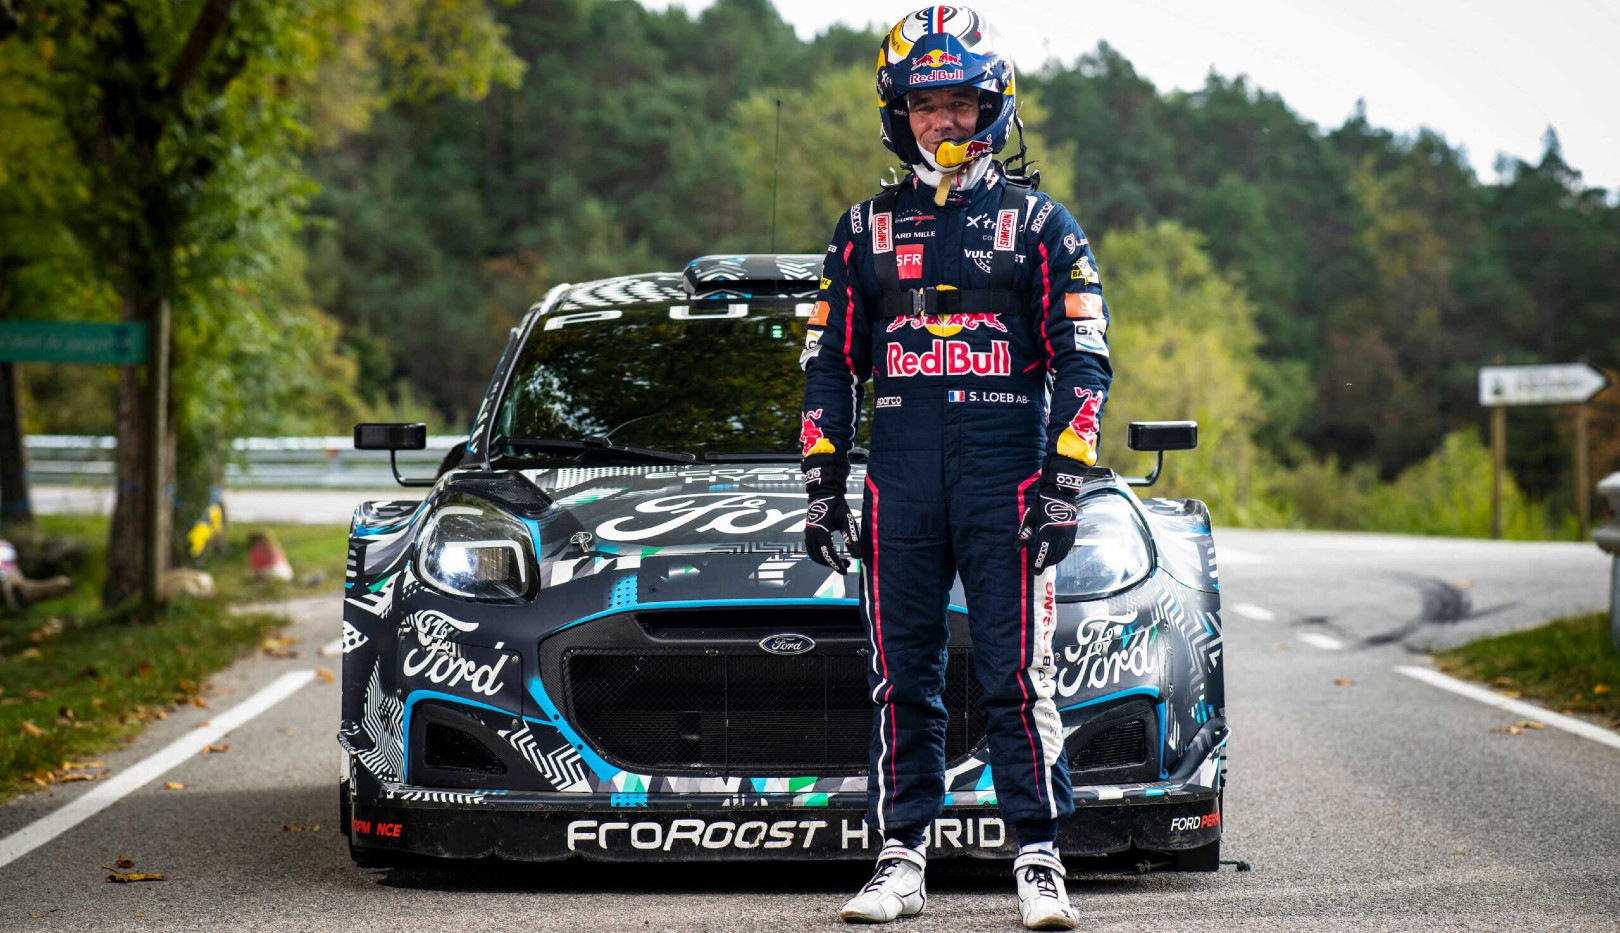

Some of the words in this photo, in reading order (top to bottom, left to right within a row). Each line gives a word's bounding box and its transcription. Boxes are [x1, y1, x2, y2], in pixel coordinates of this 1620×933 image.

[910, 72, 937, 84] Red
[937, 69, 964, 81] Bull
[877, 217, 888, 248] SIMPSON
[1000, 213, 1012, 246] SIMPSON
[896, 253, 922, 267] SFR
[887, 340, 943, 377] Red
[946, 340, 1010, 376] Bull
[969, 391, 981, 402] S.
[983, 392, 1014, 403] LOEB
[403, 610, 510, 696] Ford
[772, 637, 804, 651] Ford
[1058, 610, 1158, 697] Ford
[1170, 815, 1201, 832] FORD
